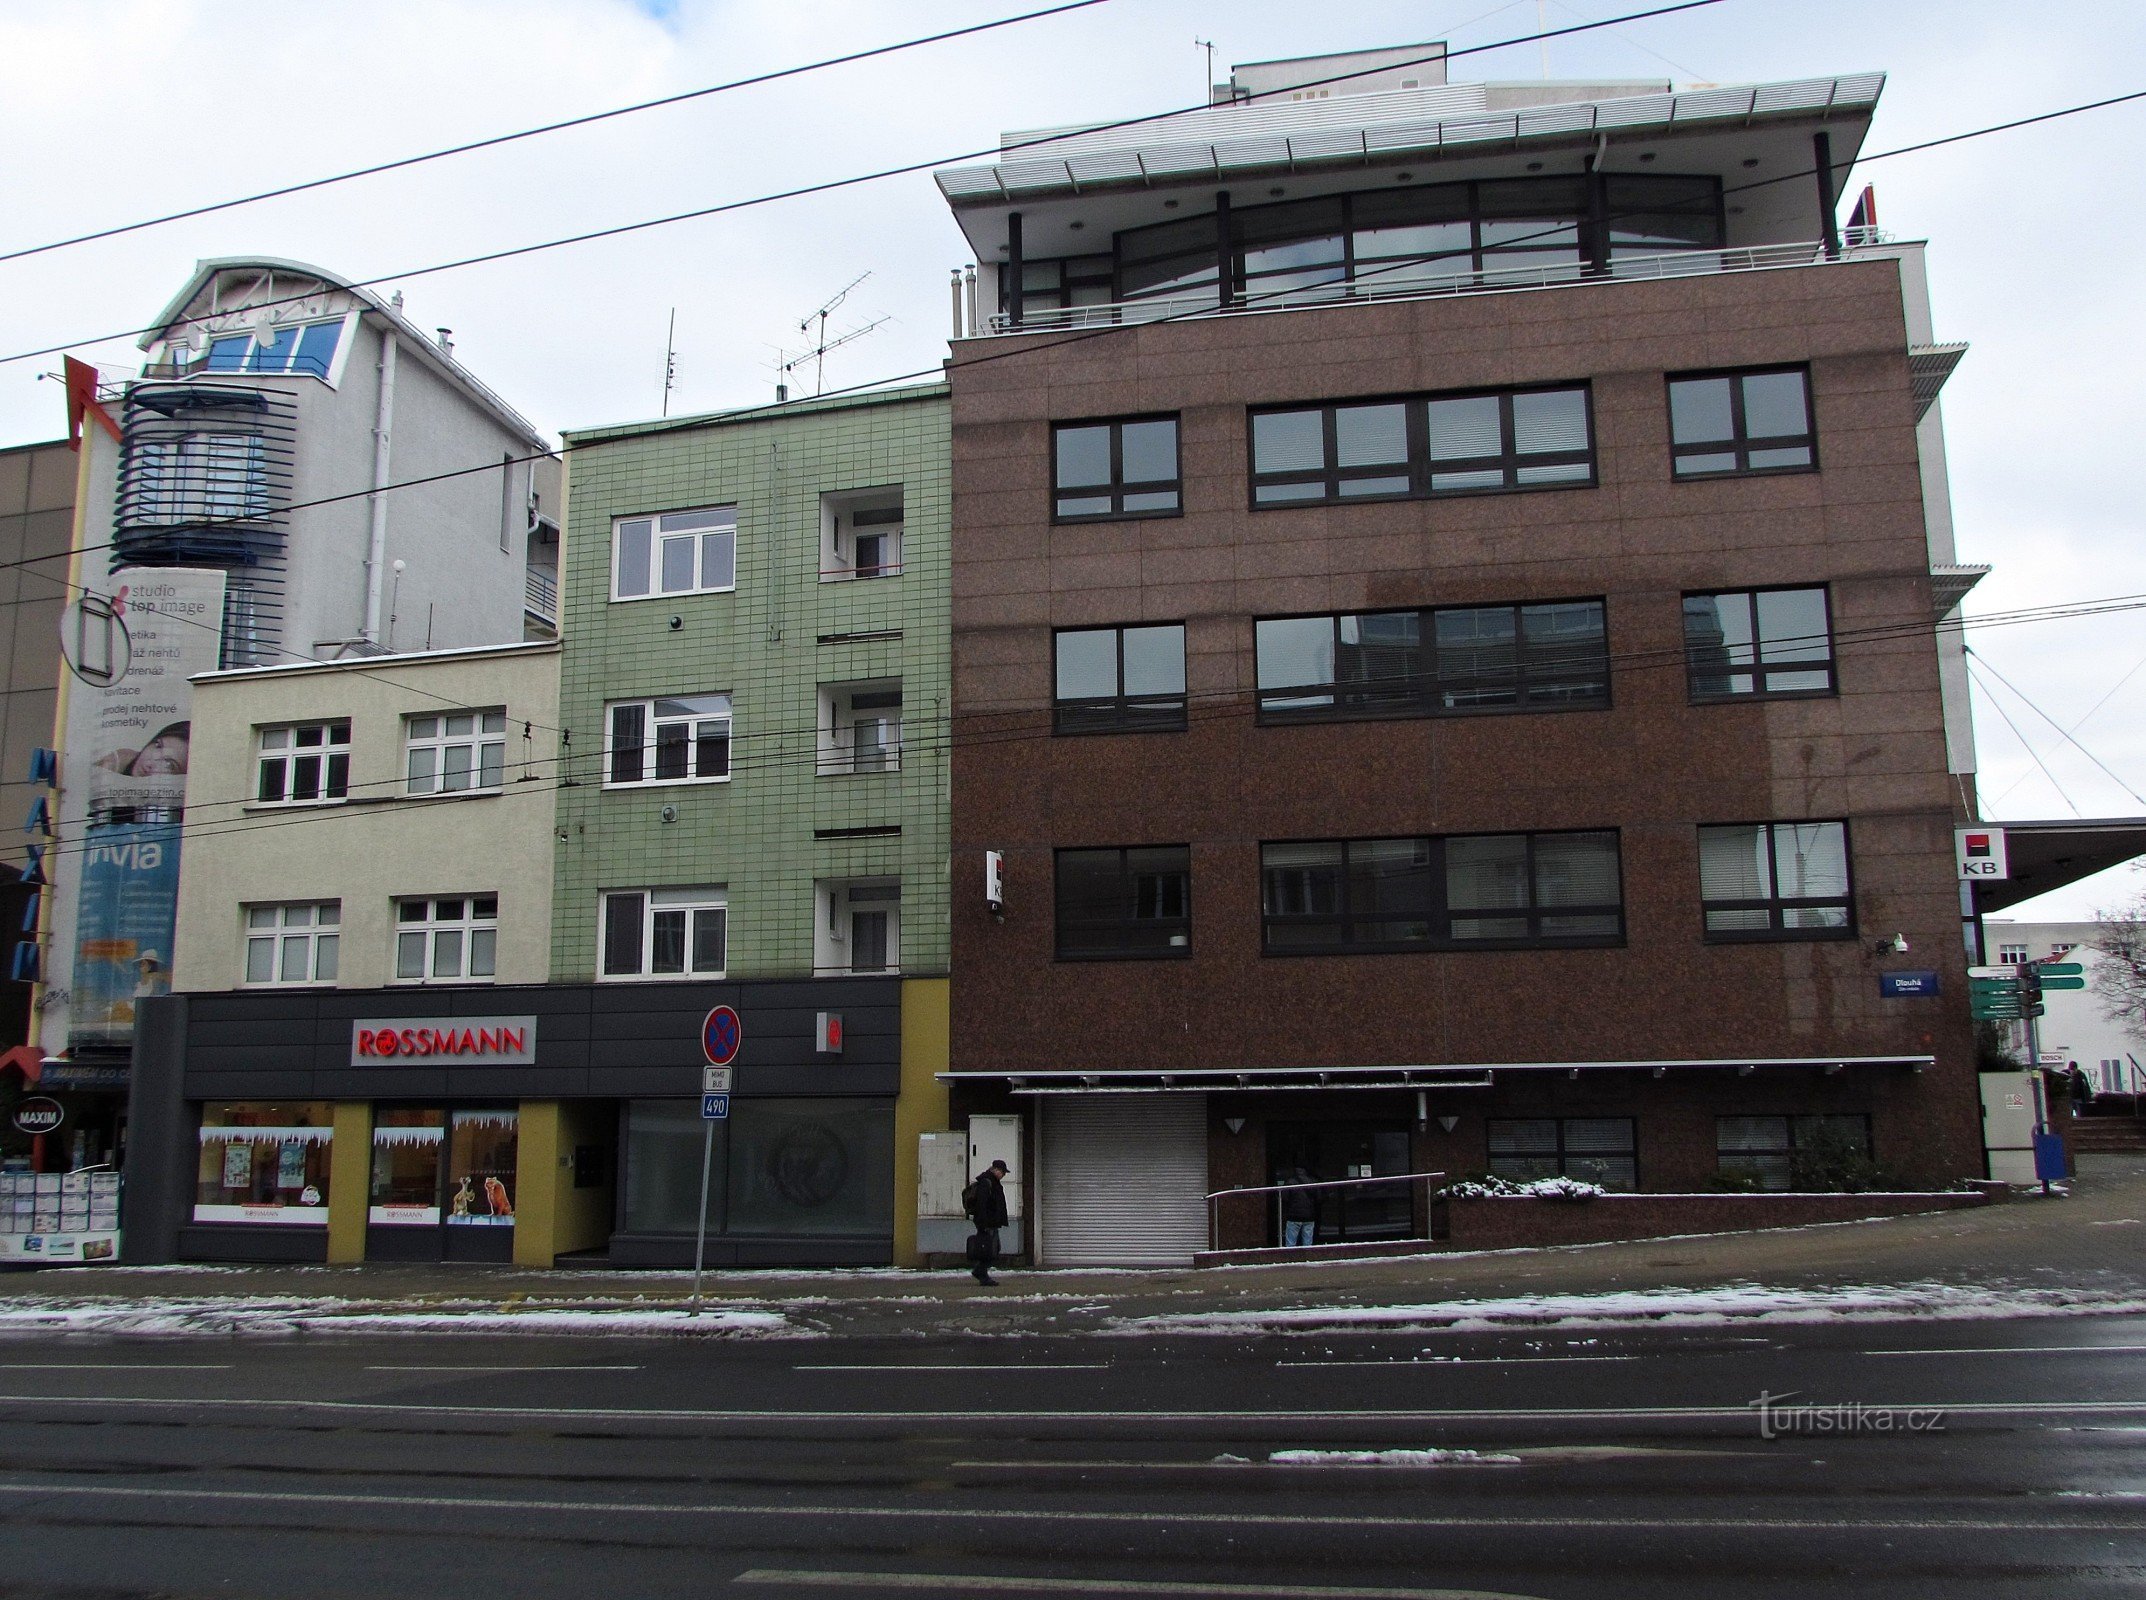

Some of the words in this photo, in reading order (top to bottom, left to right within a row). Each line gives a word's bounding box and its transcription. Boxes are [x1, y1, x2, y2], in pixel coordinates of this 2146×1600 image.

[131, 584, 176, 598] studio
[131, 601, 155, 615] top
[160, 599, 206, 616] image
[130, 630, 157, 640] etika
[126, 665, 166, 676] drenáž
[131, 703, 178, 714] nehtové
[101, 717, 149, 730] kosmetiky
[88, 834, 162, 870] invia
[1963, 862, 1997, 875] KB
[1895, 978, 1922, 986] Dlouhá
[358, 1026, 526, 1057] ROSSMANN
[712, 1080, 723, 1088] BUS
[706, 1099, 725, 1114] 490
[19, 1111, 58, 1124] MAXIM
[386, 1210, 424, 1218] ROSSMANN
